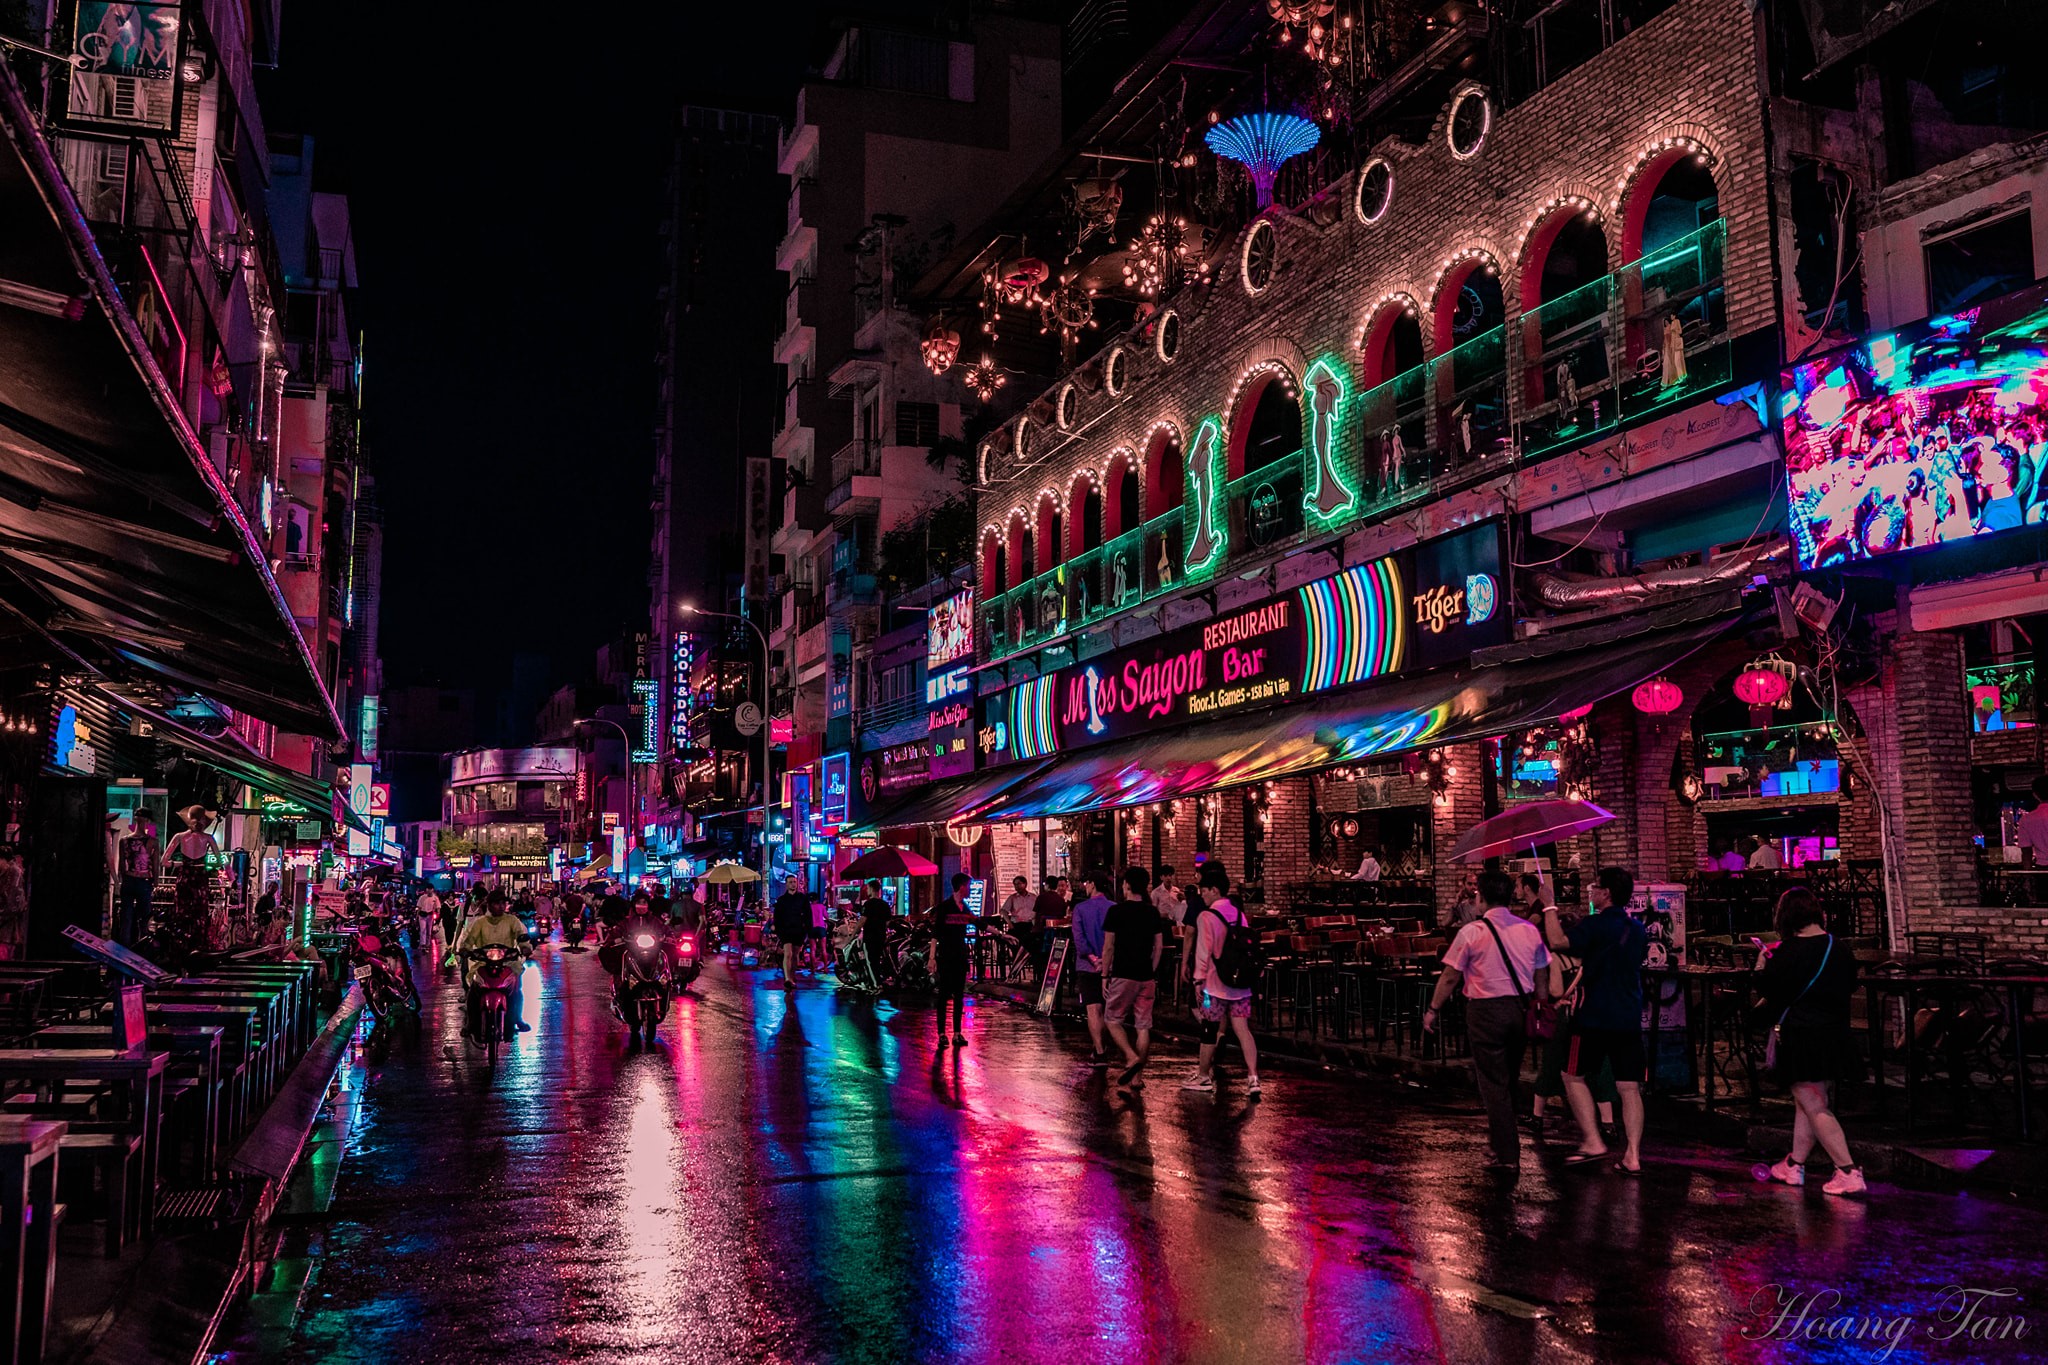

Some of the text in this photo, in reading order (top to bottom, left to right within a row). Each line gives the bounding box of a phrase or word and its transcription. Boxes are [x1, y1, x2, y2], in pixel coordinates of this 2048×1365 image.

[121, 63, 172, 80] fitness
[1413, 584, 1464, 635] Tiger
[1204, 600, 1288, 651] RESTAURANT
[677, 634, 689, 748] POOL&DART
[1121, 648, 1205, 719] Saigon
[1223, 647, 1265, 683] Bar
[1218, 687, 1245, 708] Games
[928, 711, 944, 731] Miss
[979, 726, 996, 754] Tiger
[371, 790, 383, 804] K
